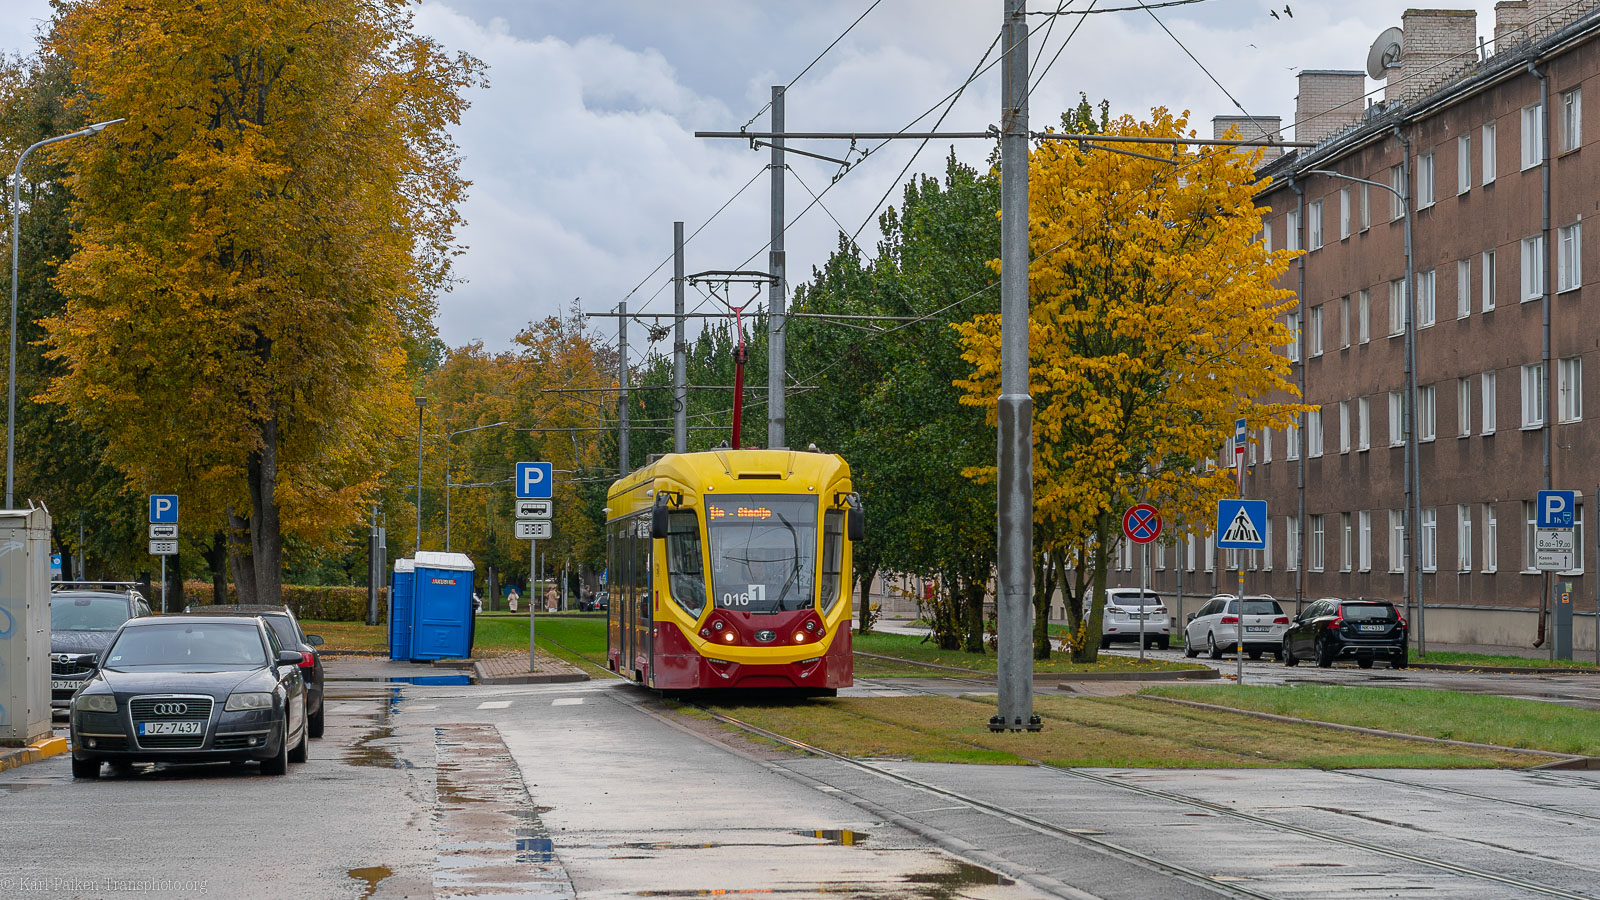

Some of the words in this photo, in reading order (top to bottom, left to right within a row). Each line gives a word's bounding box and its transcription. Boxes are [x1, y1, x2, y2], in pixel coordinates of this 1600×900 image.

[524, 467, 544, 494] P
[156, 498, 171, 520] P
[1545, 495, 1566, 524] P
[723, 592, 749, 606] 016
[147, 722, 200, 734] JZ-7437
